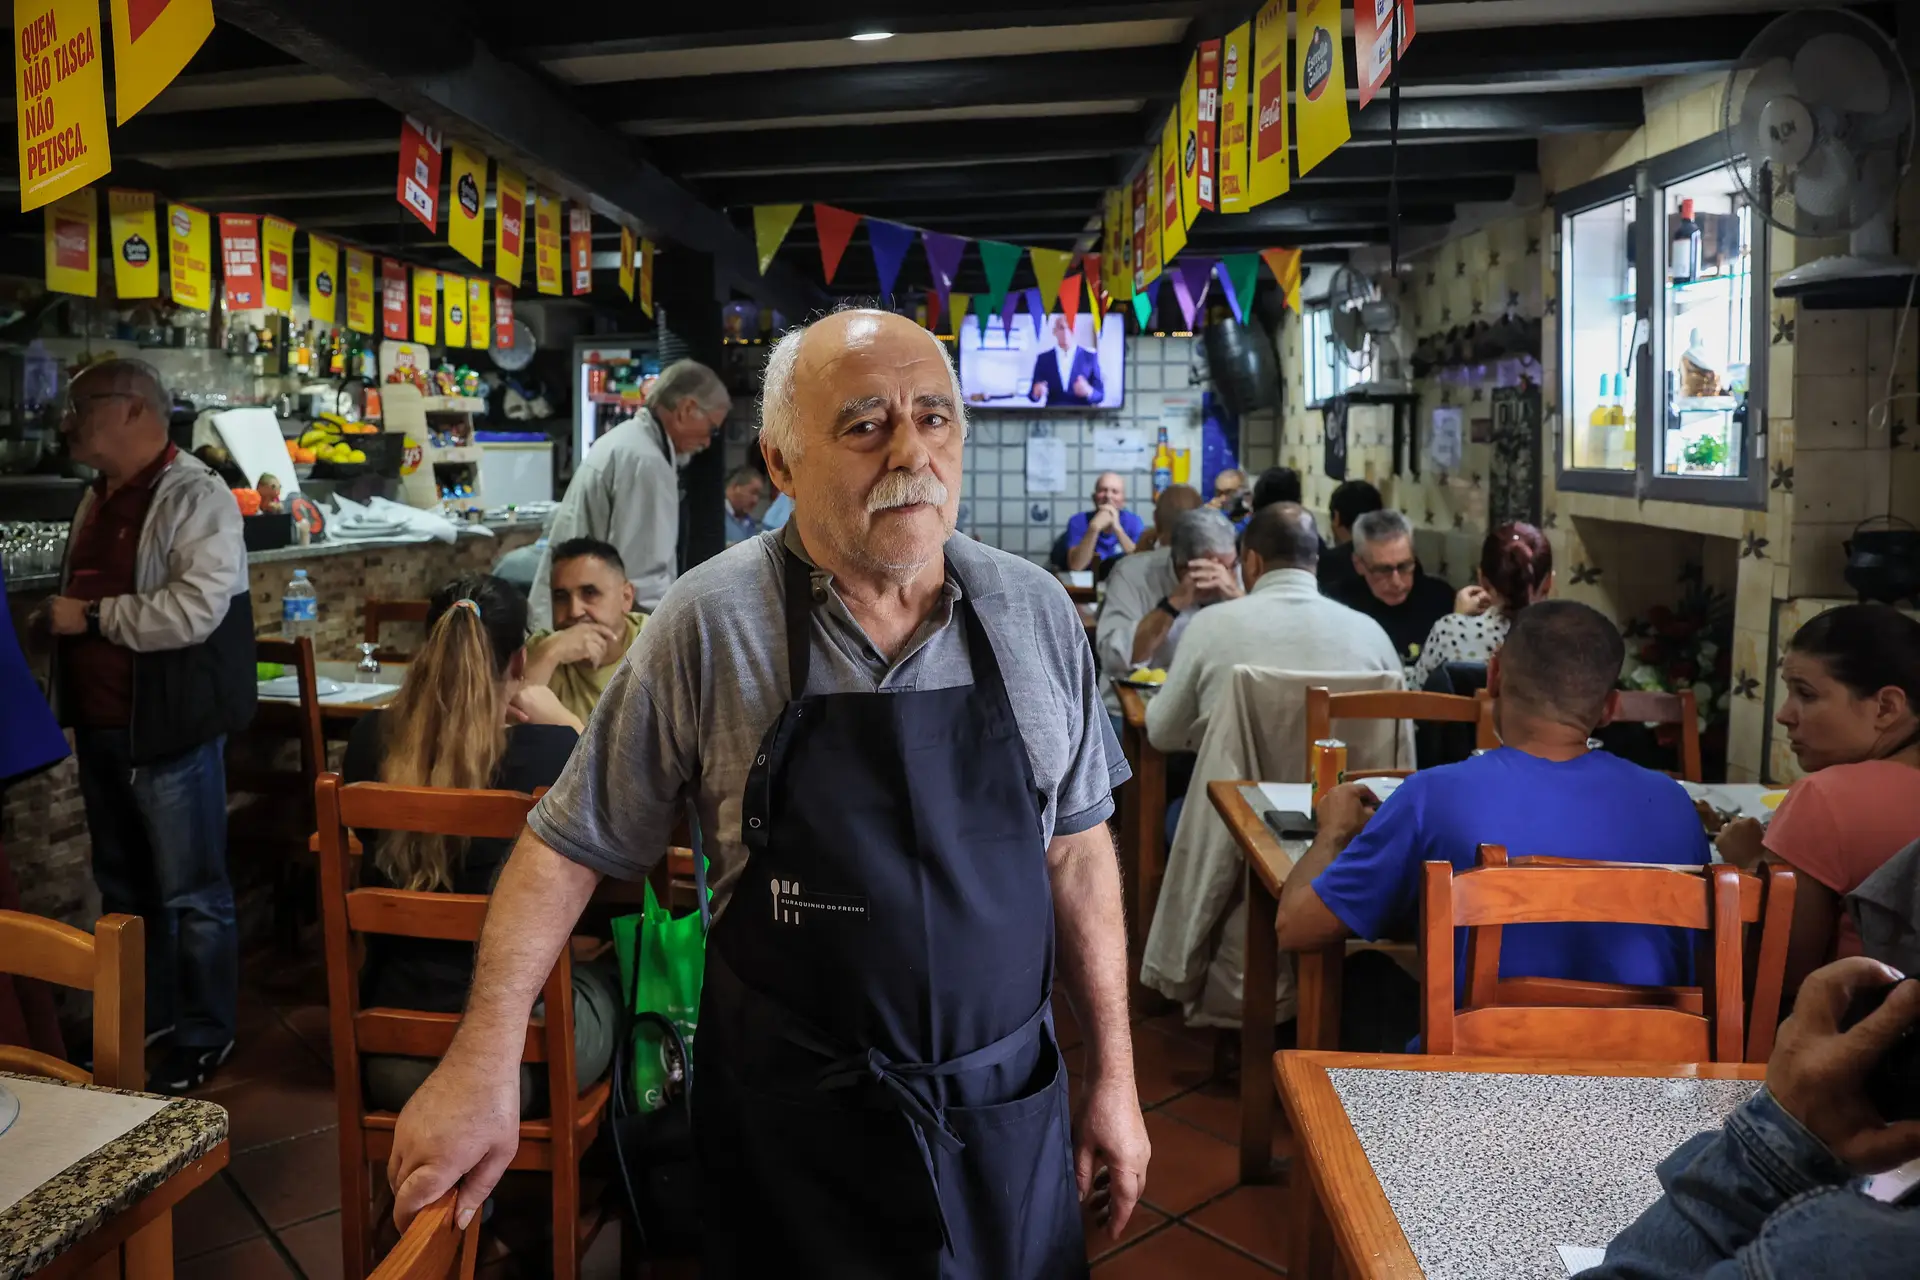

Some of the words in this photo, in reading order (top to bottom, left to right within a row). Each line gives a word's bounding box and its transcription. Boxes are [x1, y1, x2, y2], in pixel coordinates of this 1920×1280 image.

[22, 9, 57, 64] QUEM
[24, 55, 51, 101] NÃO
[54, 27, 95, 83] TASCA
[25, 94, 55, 141] NÃO
[27, 123, 88, 180] PETISCA.
